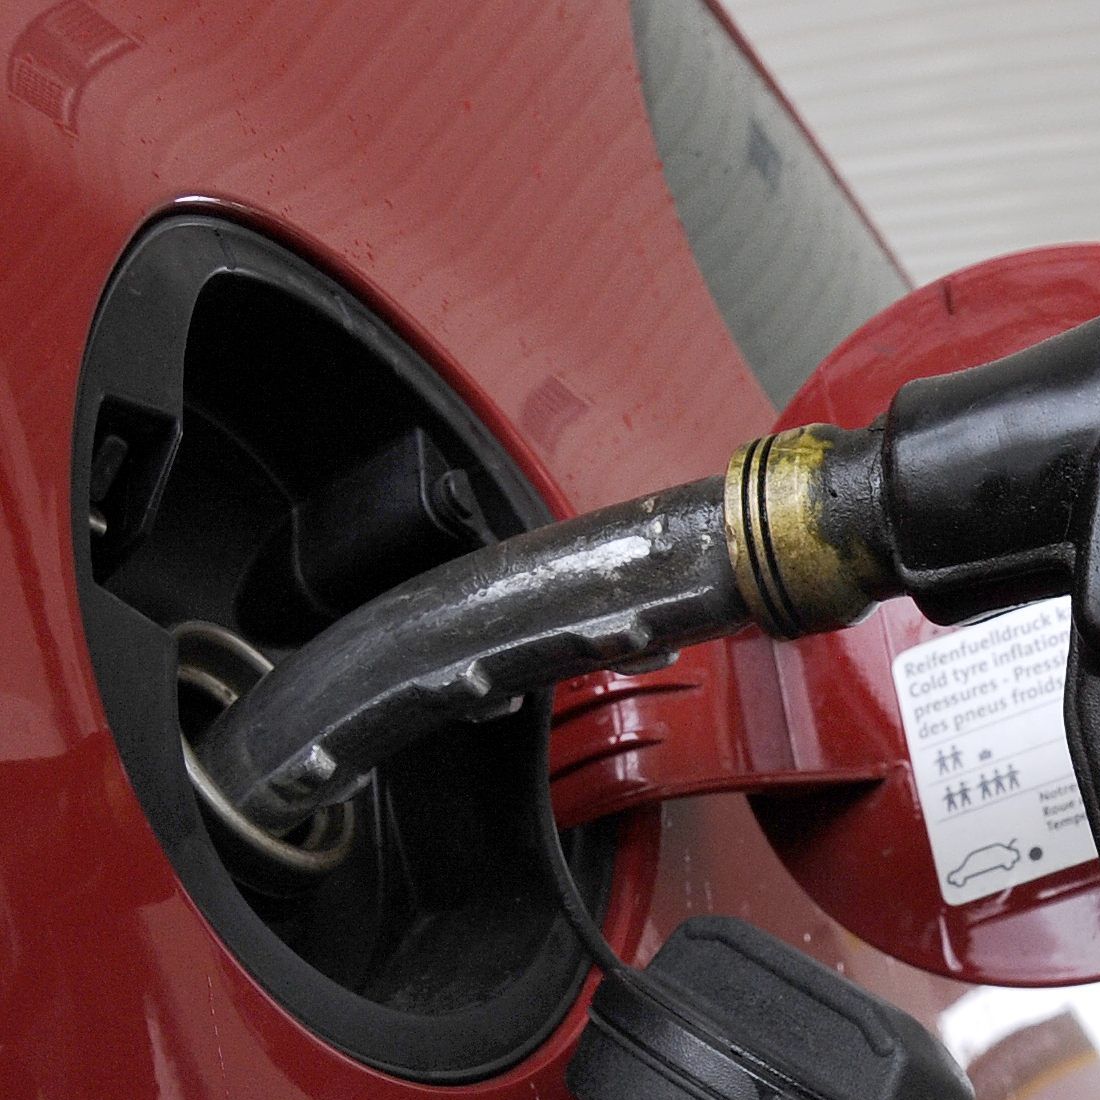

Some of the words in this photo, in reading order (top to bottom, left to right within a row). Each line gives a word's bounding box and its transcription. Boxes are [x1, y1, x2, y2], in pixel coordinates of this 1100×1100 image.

[904, 611, 1052, 679] Reifenfuelldruck
[909, 671, 948, 698] Cold
[952, 659, 989, 685] tyre
[992, 630, 1069, 667] inflation
[914, 679, 998, 723] pressures
[1013, 650, 1065, 682] Pressi
[919, 720, 948, 739] des
[953, 697, 1008, 731] pneus
[1011, 675, 1063, 705] froids
